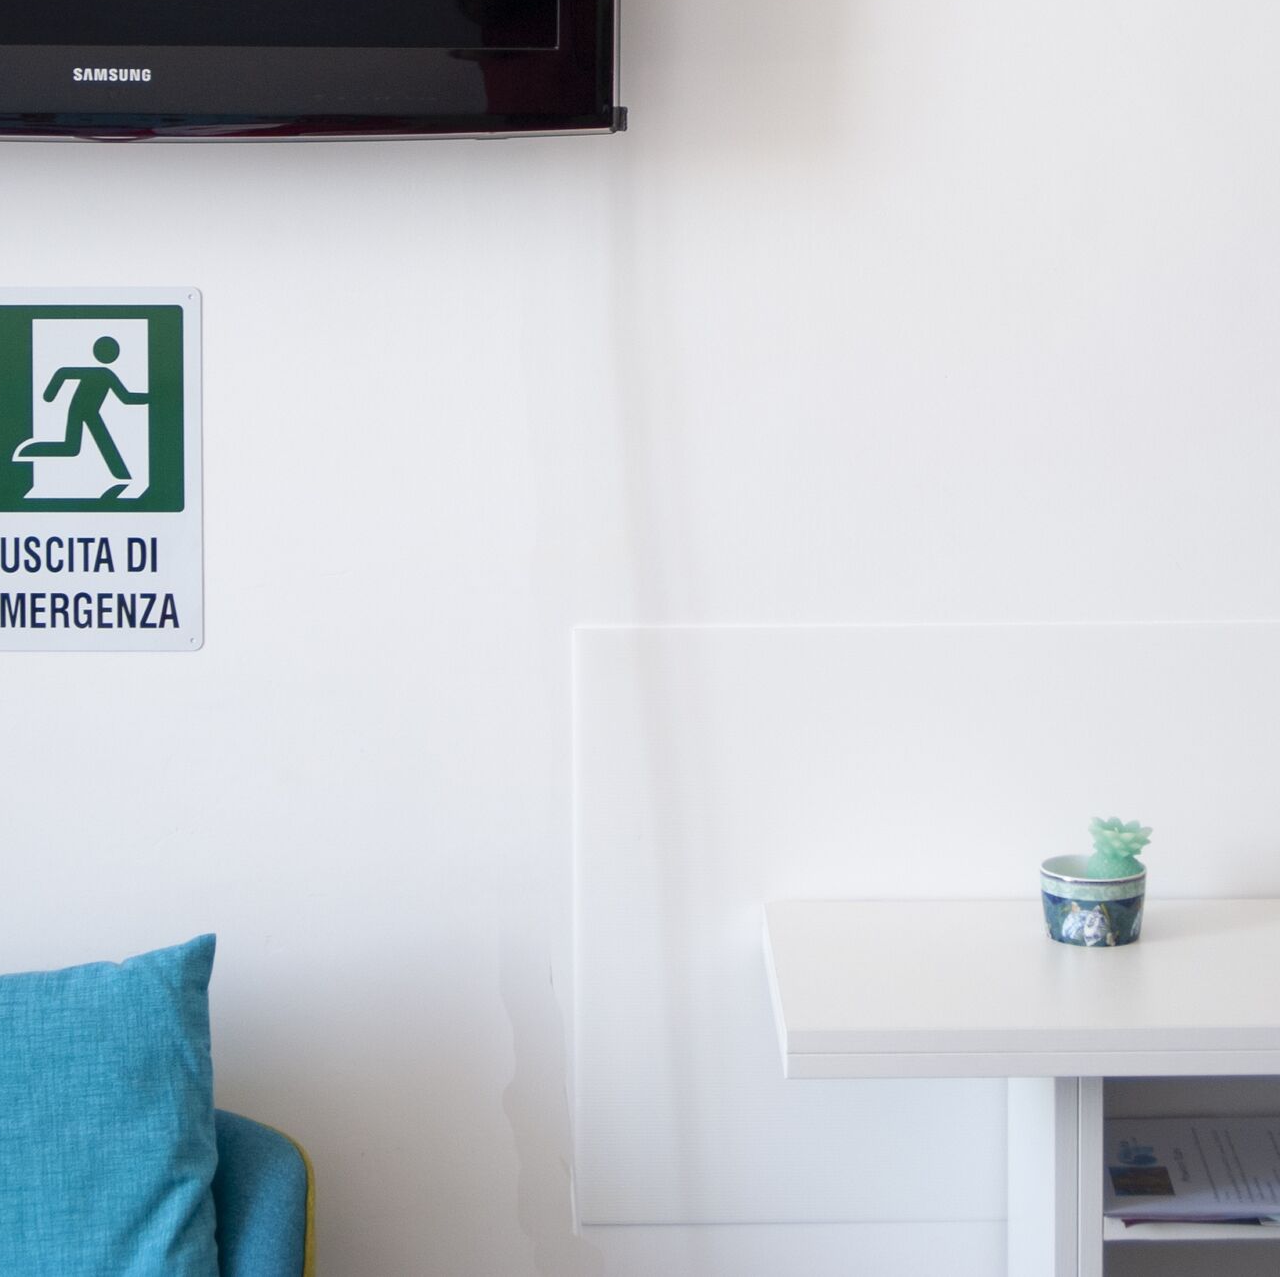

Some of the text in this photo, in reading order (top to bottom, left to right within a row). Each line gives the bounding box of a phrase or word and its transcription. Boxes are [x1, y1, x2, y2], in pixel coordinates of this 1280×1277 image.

[72, 67, 151, 82] SAMSUNG
[0, 536, 158, 573] USCITA DI
